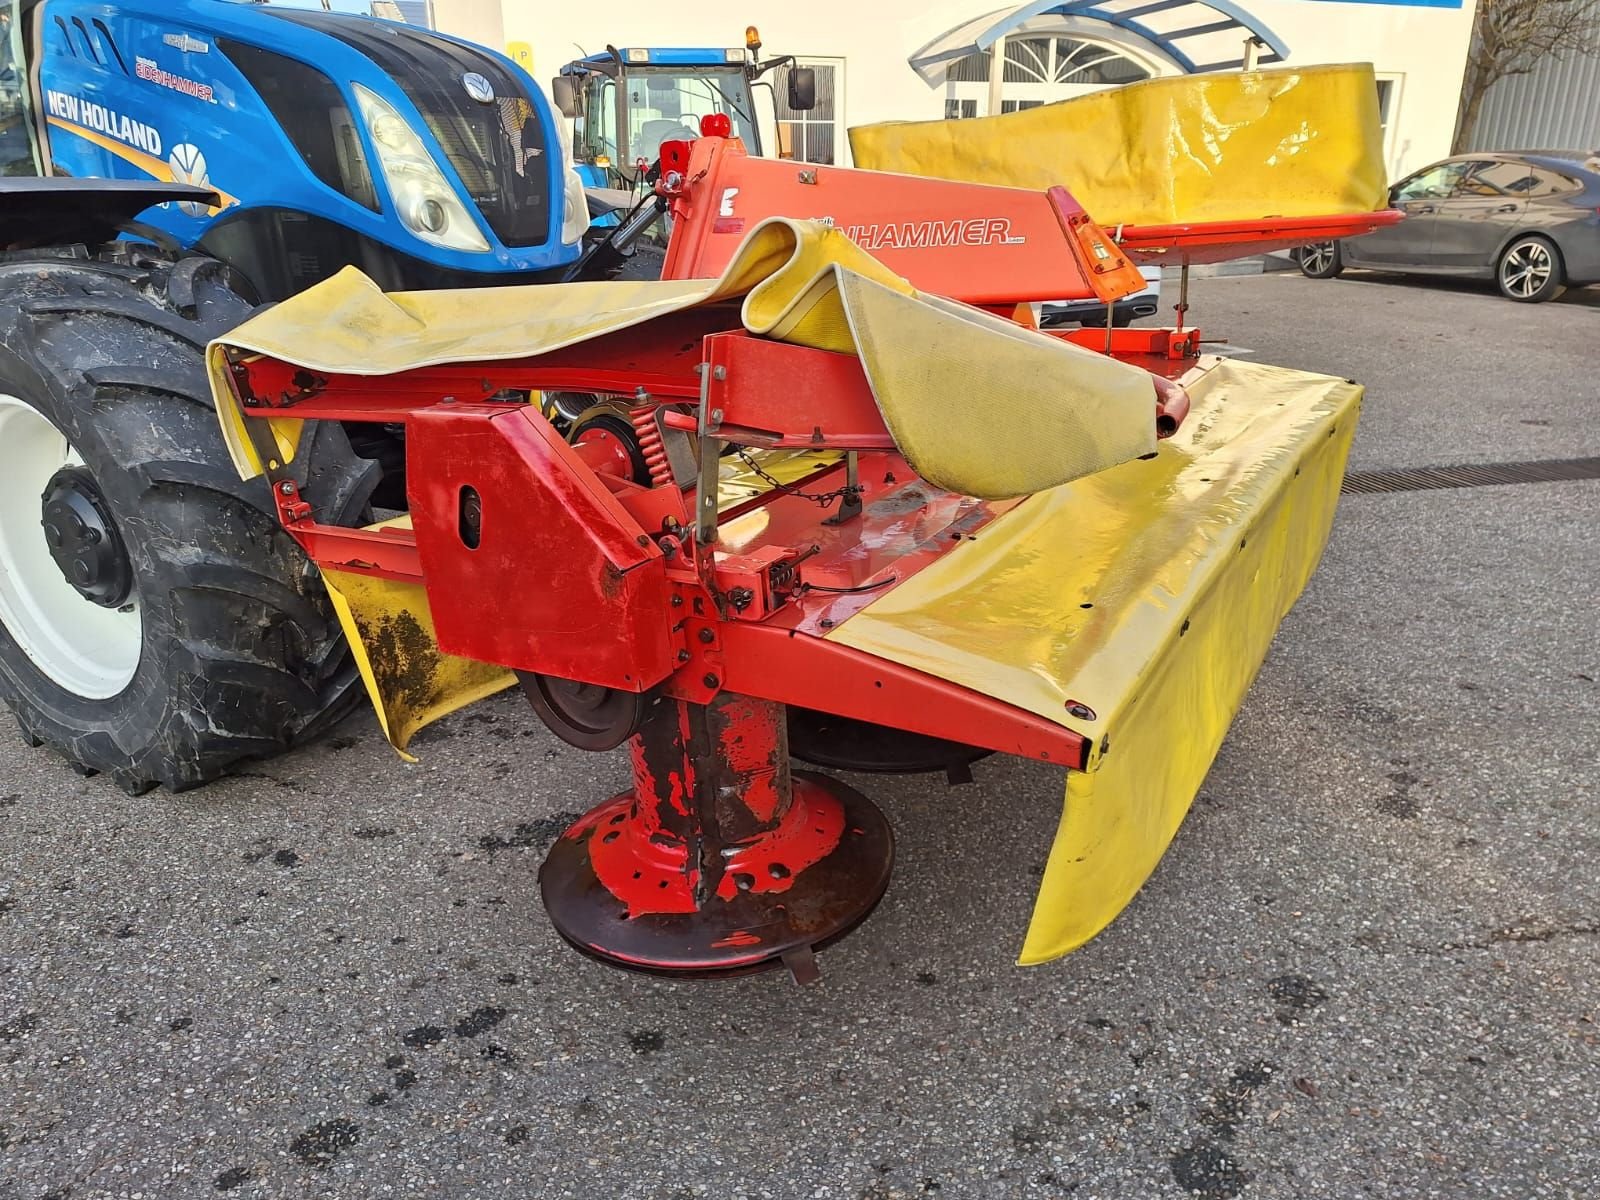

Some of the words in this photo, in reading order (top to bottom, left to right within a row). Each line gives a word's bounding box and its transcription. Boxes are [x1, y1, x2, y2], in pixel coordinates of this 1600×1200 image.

[47, 89, 79, 122] NEW
[80, 99, 162, 156] HOLLAND
[834, 217, 1011, 249] NHAMMER
